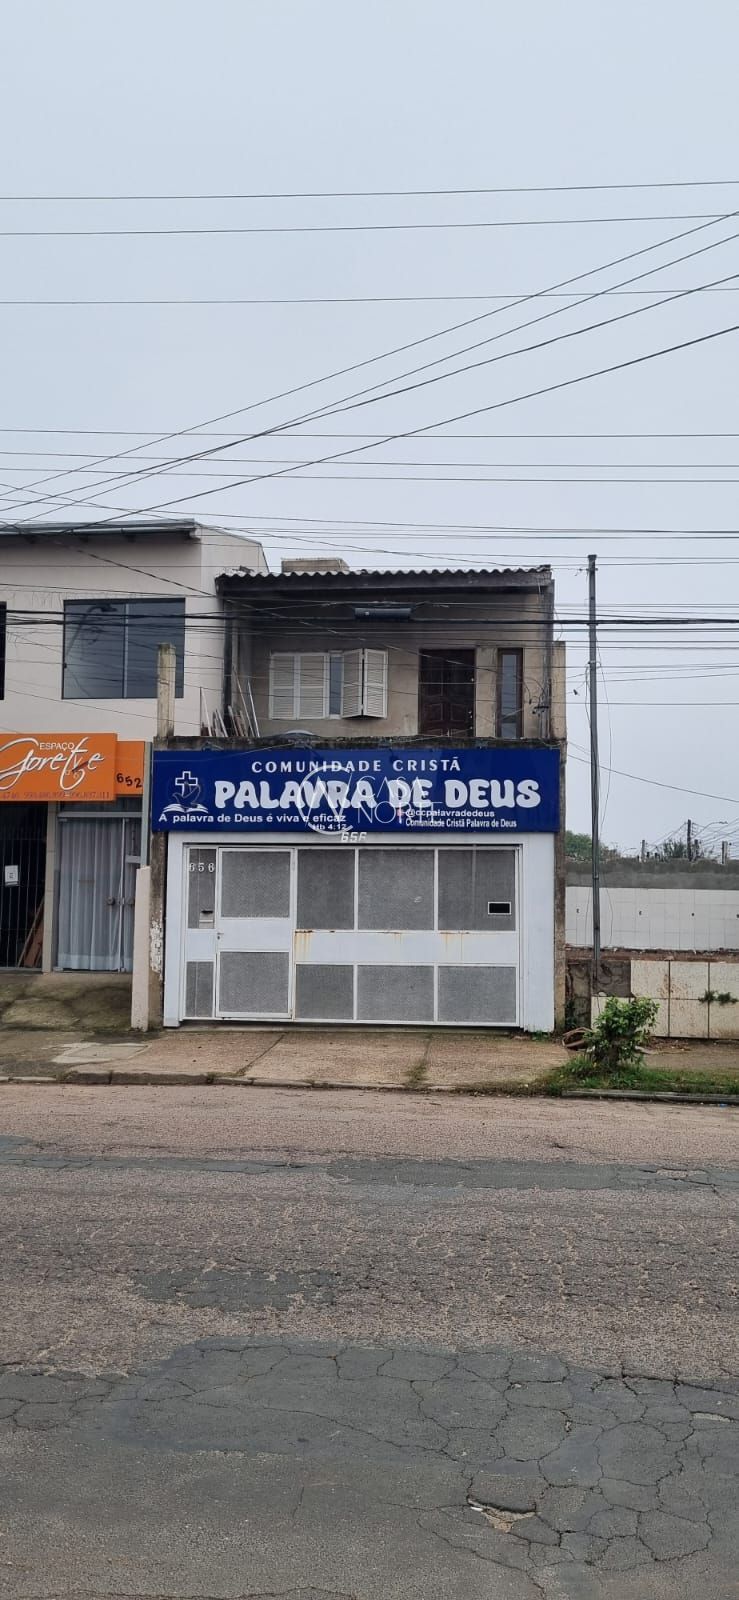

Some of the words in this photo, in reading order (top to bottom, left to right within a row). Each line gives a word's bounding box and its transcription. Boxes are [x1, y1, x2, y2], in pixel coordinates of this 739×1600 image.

[39, 742, 75, 751] ESPAÇO
[251, 760, 382, 773] COMUNIDADE
[392, 756, 461, 772] CRISTÃ
[116, 772, 143, 788] 652
[214, 780, 378, 809] PALAVRA
[388, 779, 433, 808] DE
[444, 779, 542, 808] DEUS
[158, 814, 167, 822] A
[173, 813, 213, 824] palavra
[217, 813, 231, 822] de
[234, 814, 263, 823] Deus
[266, 813, 273, 822] é
[276, 814, 299, 822] viva
[312, 813, 347, 823] eficaz
[405, 819, 445, 827] Comunidade
[446, 818, 465, 827] Cristã
[466, 819, 490, 827] Palavra
[492, 819, 499, 827] de
[500, 819, 517, 827] Deus
[188, 863, 215, 872] 656
